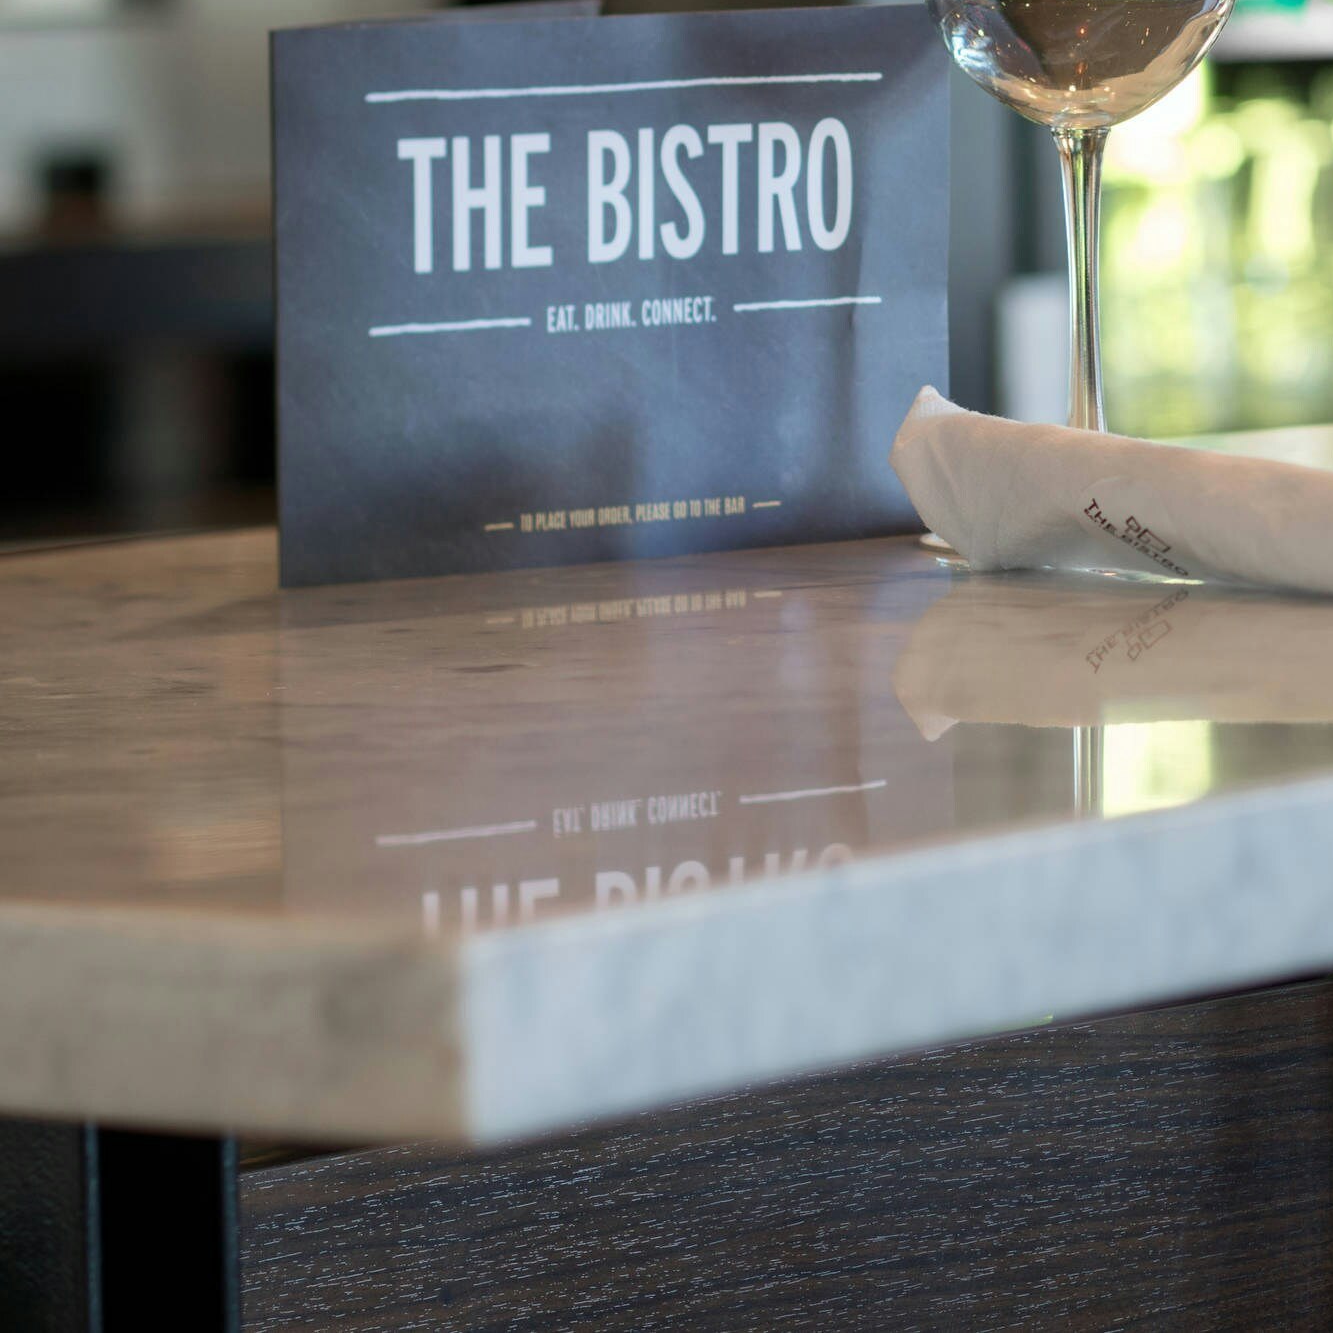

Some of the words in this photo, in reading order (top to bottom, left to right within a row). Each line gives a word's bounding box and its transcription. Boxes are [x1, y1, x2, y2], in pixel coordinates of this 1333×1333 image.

[397, 132, 553, 273] THE
[586, 117, 854, 264] BISTRO
[547, 305, 580, 333] EAT.
[584, 301, 637, 331] DRINK.
[641, 295, 718, 327] CONNECT.
[520, 513, 533, 533] TO
[536, 511, 566, 531] PLACE
[570, 508, 595, 528] YOUR
[636, 502, 670, 523] PLEASE
[689, 499, 701, 518] TO
[704, 497, 721, 517] THE
[724, 496, 745, 516] BAR
